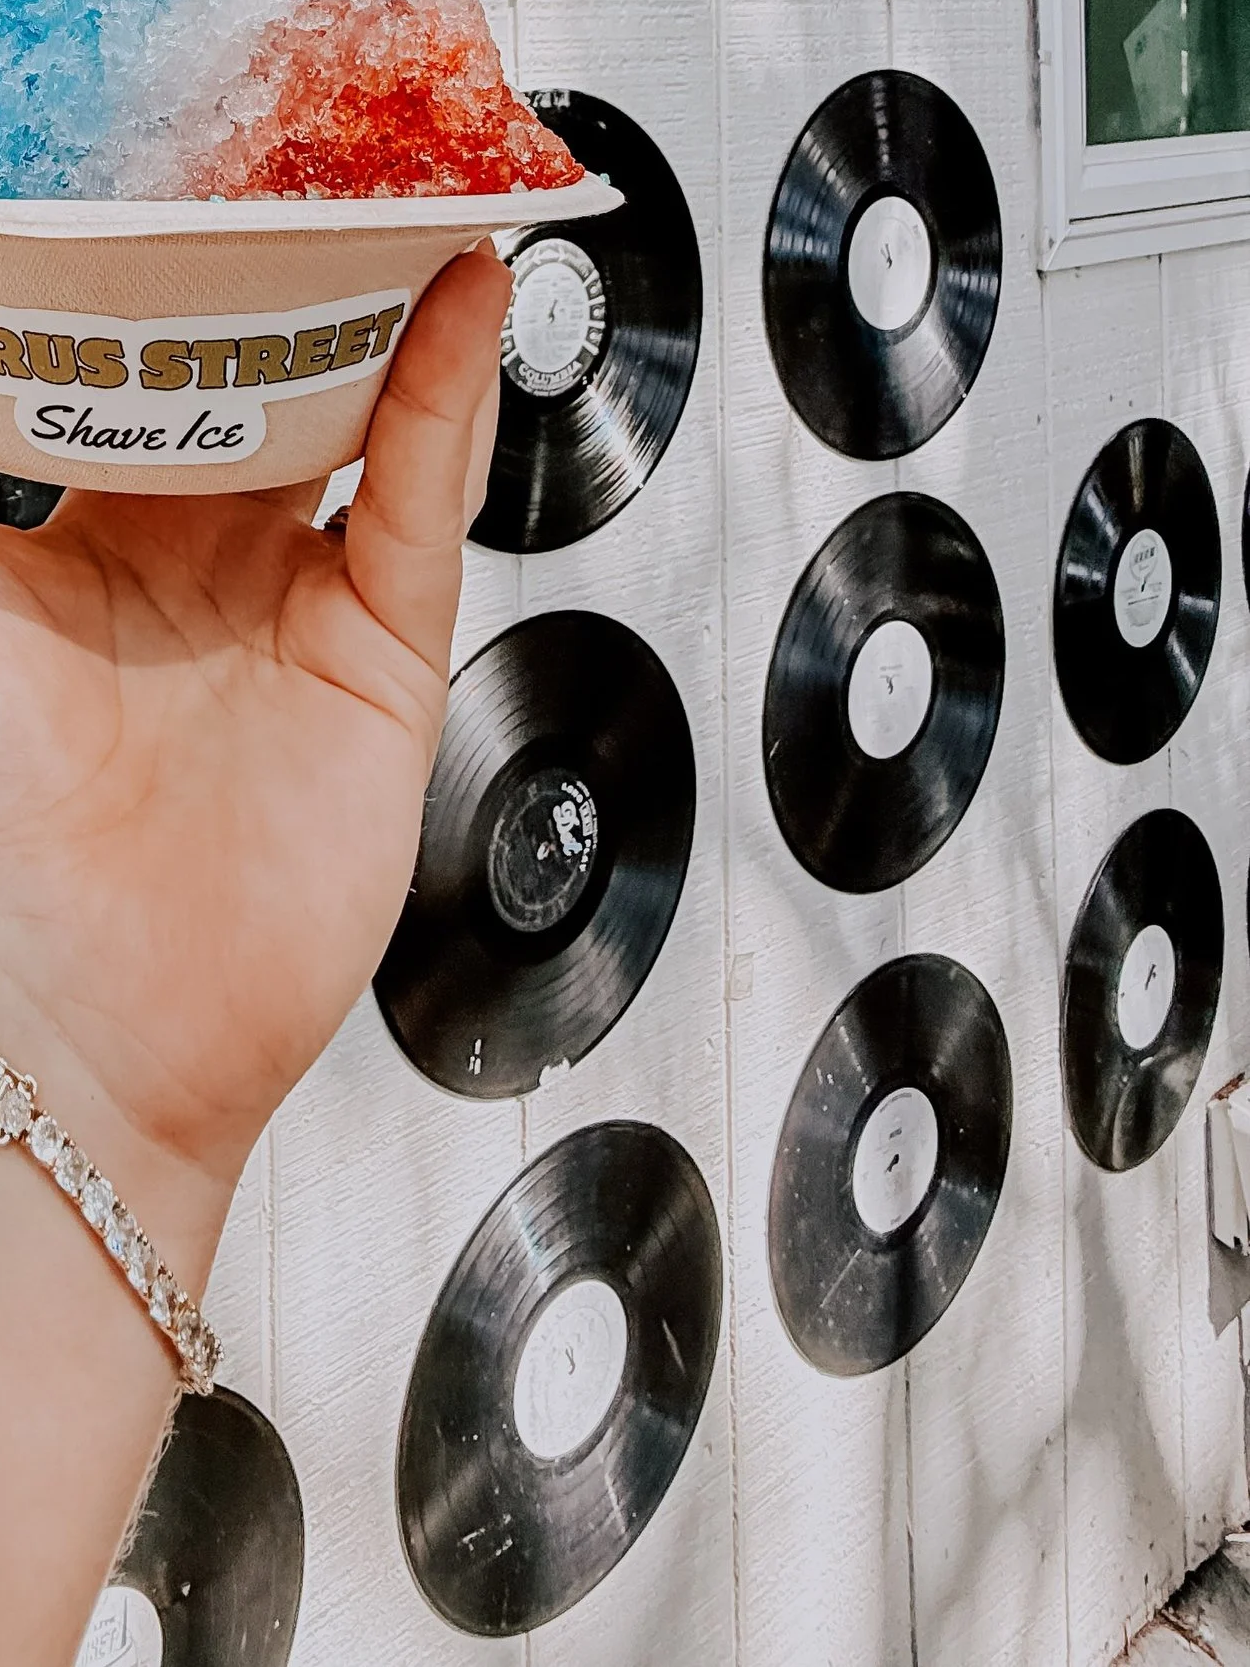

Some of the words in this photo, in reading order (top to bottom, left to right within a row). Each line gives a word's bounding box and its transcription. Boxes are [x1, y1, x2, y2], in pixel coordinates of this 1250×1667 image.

[138, 302, 406, 391] STREET
[30, 404, 168, 451] Shave
[177, 410, 245, 450] Ice
